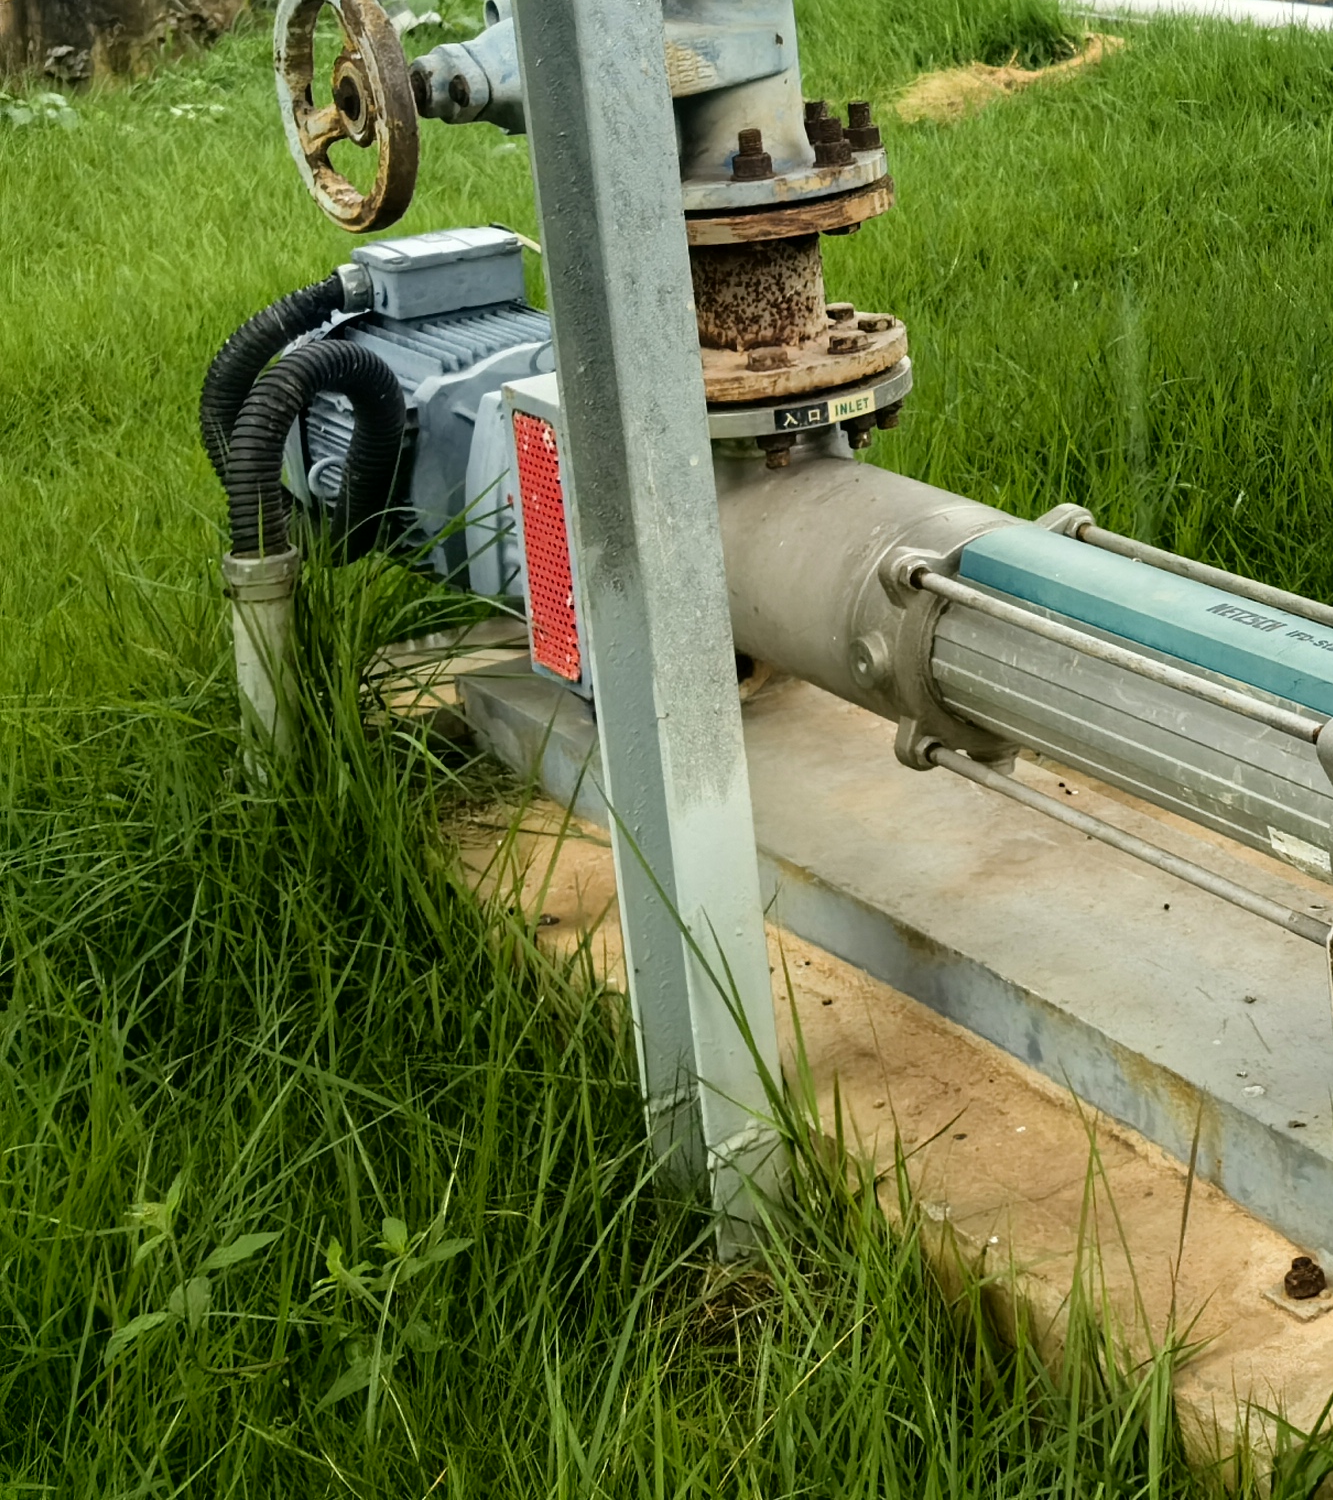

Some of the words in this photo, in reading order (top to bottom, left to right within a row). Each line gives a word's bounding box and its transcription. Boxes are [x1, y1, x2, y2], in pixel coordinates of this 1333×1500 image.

[835, 398, 869, 417] INLET
[783, 409, 820, 428] 入口
[1206, 603, 1288, 632] NETZSCH
